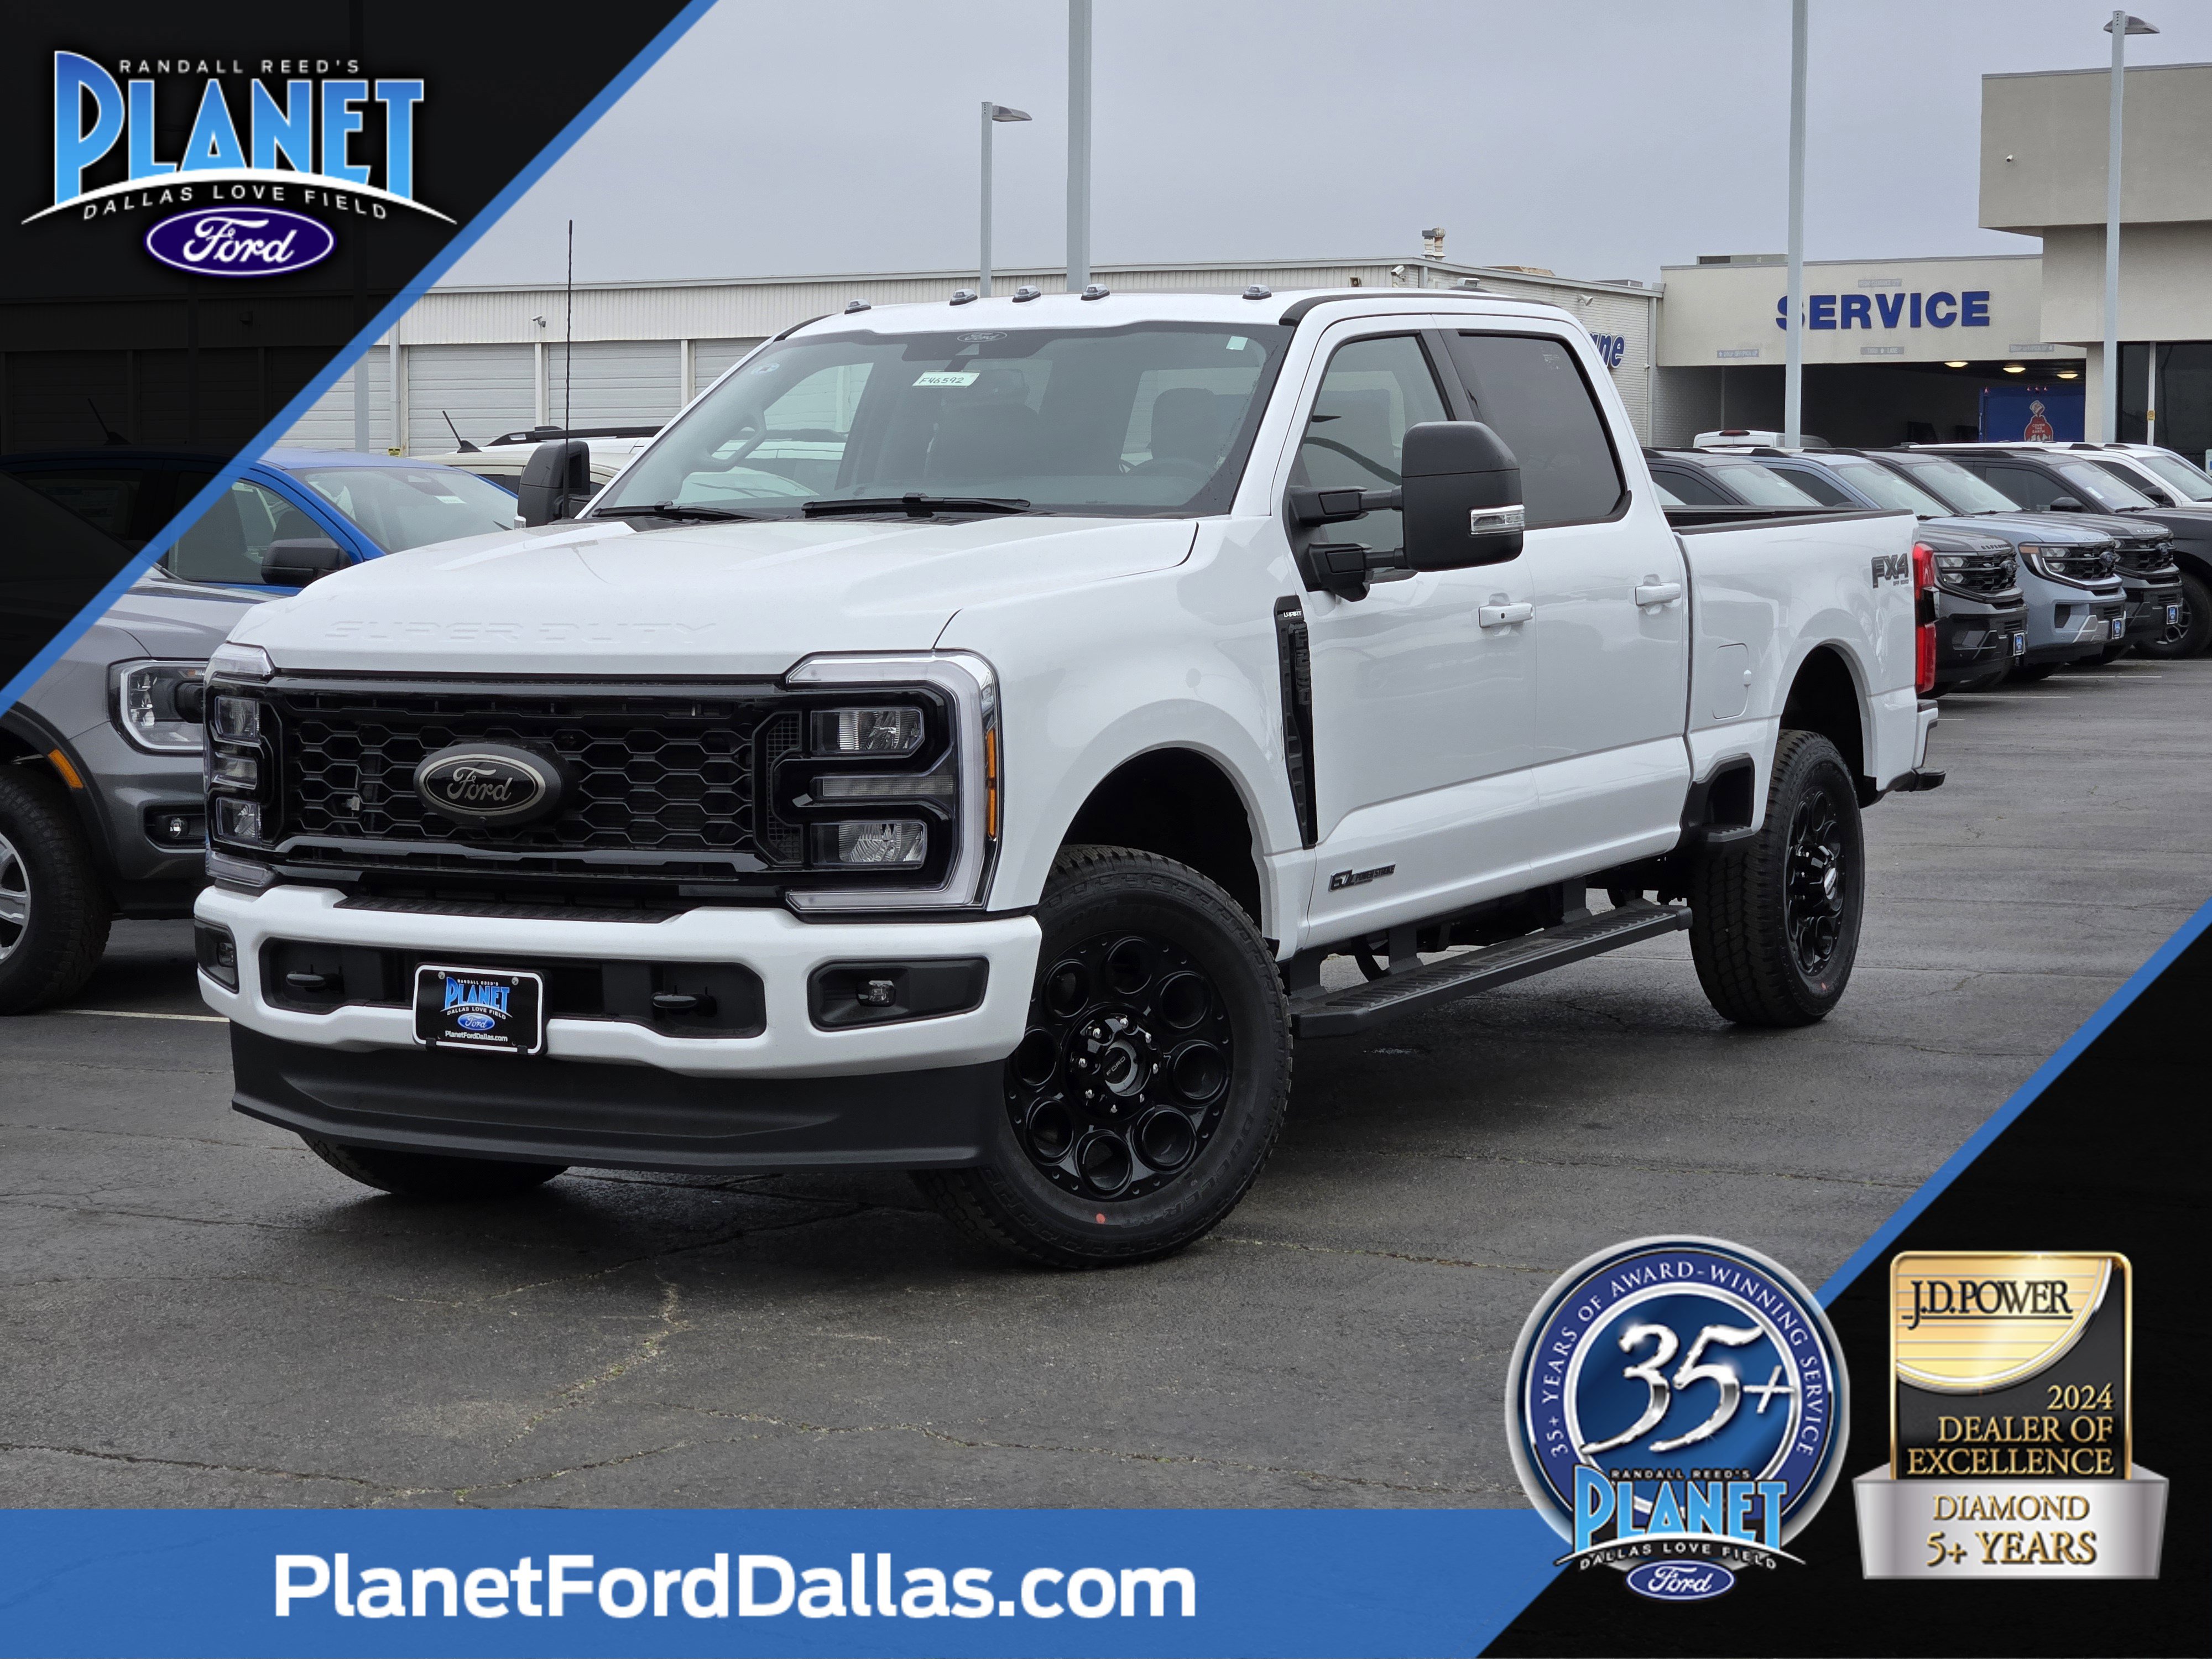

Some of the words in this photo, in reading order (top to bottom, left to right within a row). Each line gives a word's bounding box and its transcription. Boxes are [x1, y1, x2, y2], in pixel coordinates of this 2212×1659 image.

[964, 332, 1000, 341] Ford
[1871, 553, 1908, 588] FX4
[325, 620, 524, 643] SUPER
[535, 621, 716, 644] DUTY
[446, 766, 513, 801] Ford
[445, 977, 510, 1013] PLANET
[447, 1006, 469, 1016] DALLAS
[489, 1009, 506, 1020] FIELD
[465, 1015, 487, 1029] Ford
[445, 1030, 508, 1042] PlanetFordDallas.com
[1106, 1056, 1126, 1076] FORD
